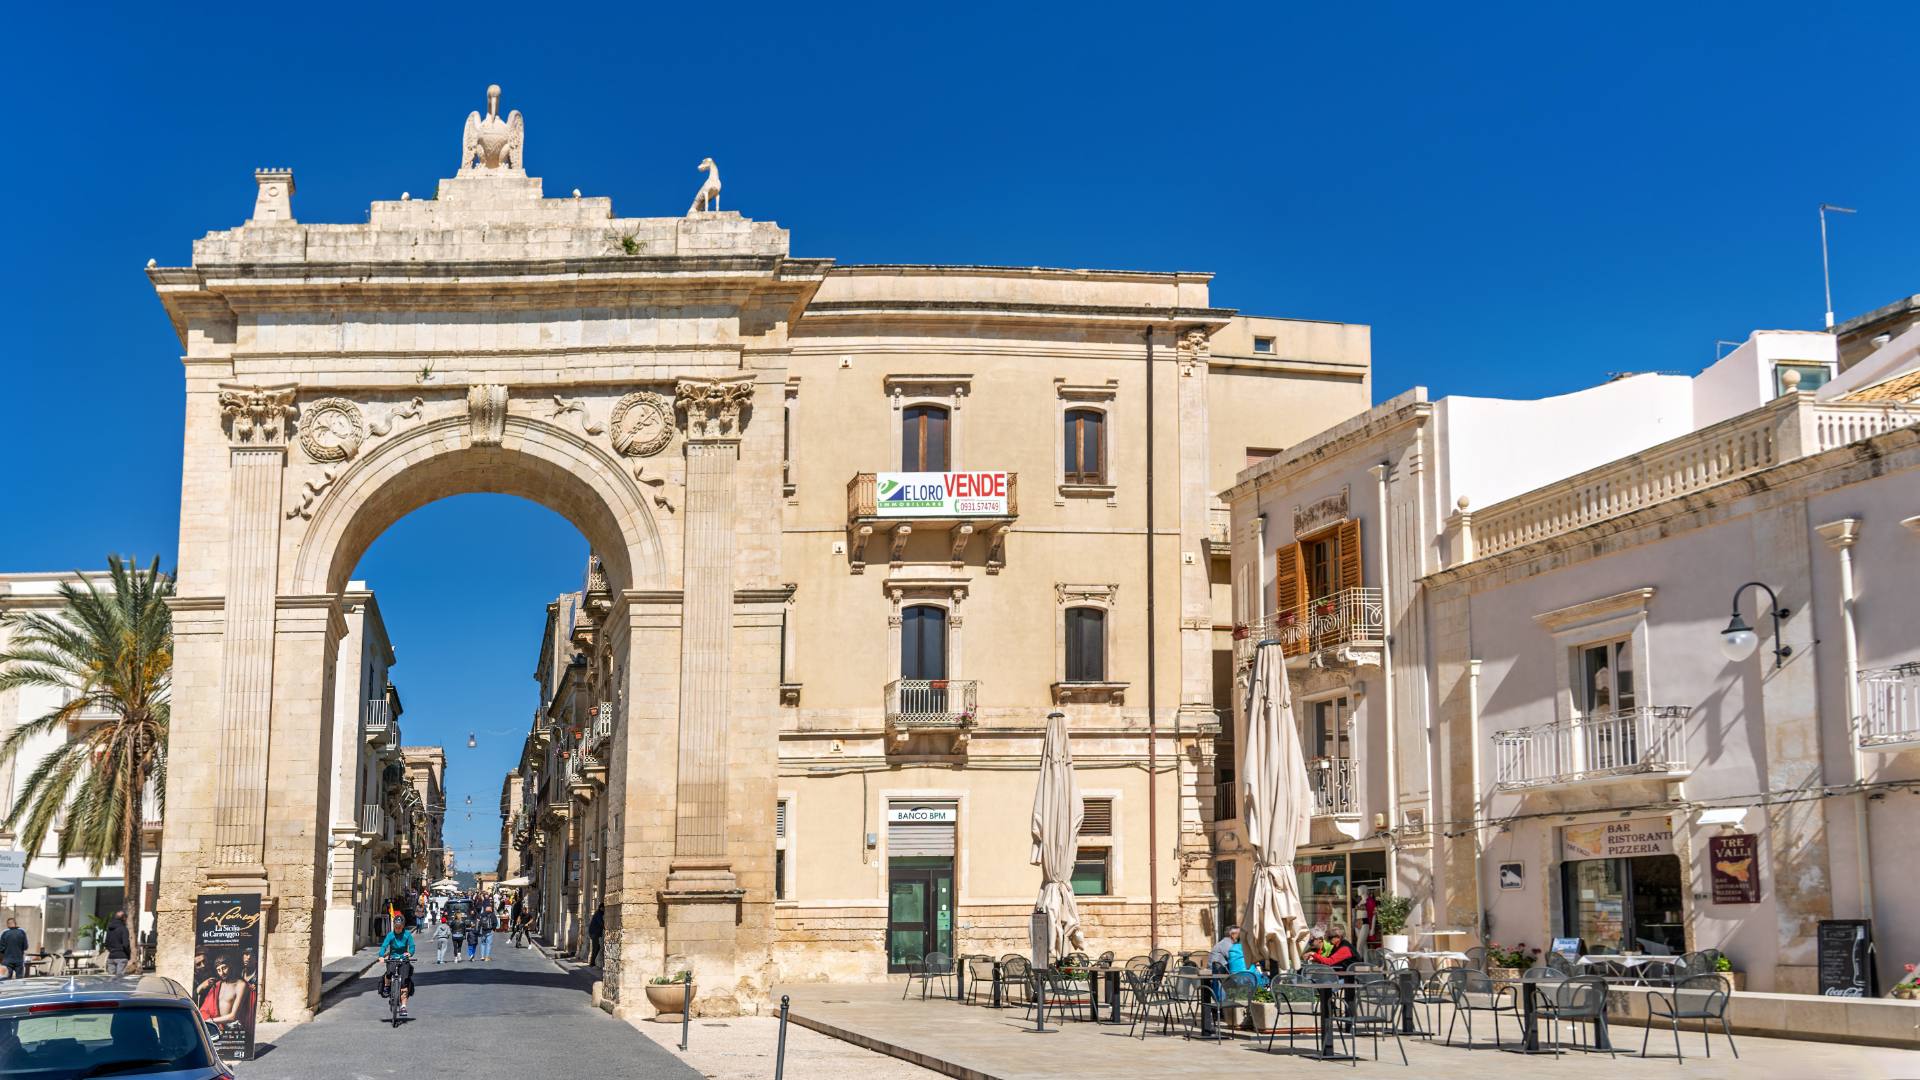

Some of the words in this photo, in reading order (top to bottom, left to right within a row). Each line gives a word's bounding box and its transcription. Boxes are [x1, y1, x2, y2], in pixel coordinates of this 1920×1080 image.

[944, 474, 1005, 497] VENDE
[905, 485, 943, 501] ELORO
[898, 812, 928, 820] BANCO
[929, 812, 946, 820] BPM
[1607, 824, 1631, 833] BAR
[1721, 838, 1744, 847] TRE
[1608, 843, 1660, 855] PIZZERIA
[1716, 848, 1752, 857] VALLI
[209, 930, 240, 939] Caravaggio
